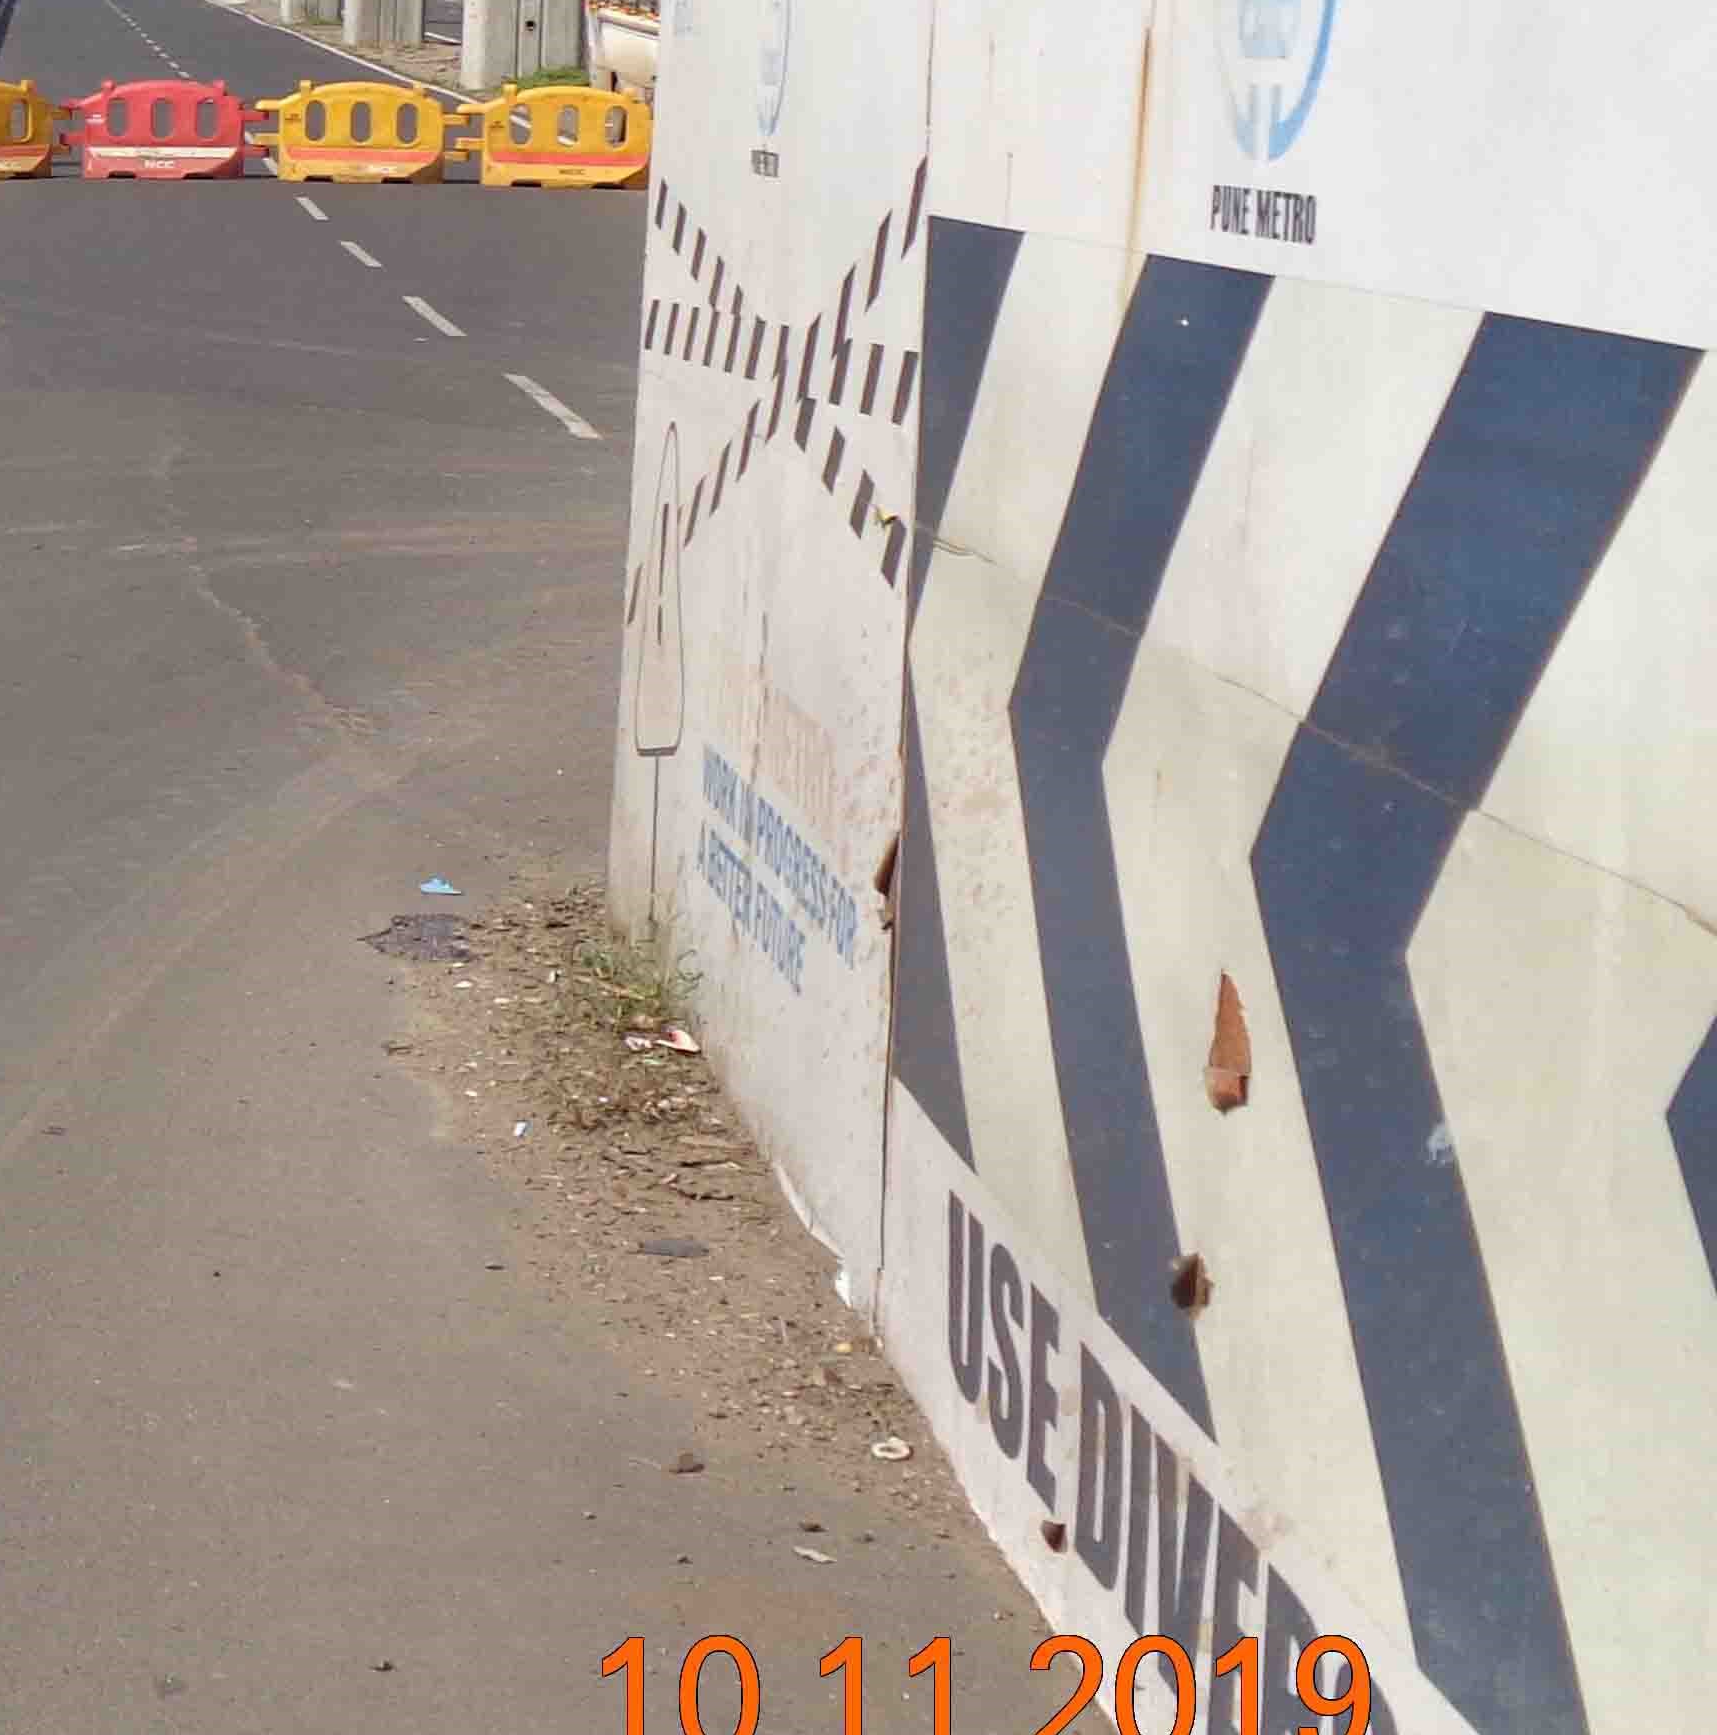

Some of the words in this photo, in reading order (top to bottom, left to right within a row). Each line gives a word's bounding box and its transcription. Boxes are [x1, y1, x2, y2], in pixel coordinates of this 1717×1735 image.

[1210, 184, 1251, 235] PUNE
[1254, 189, 1317, 245] METRO
[947, 1189, 1059, 1516] USE
